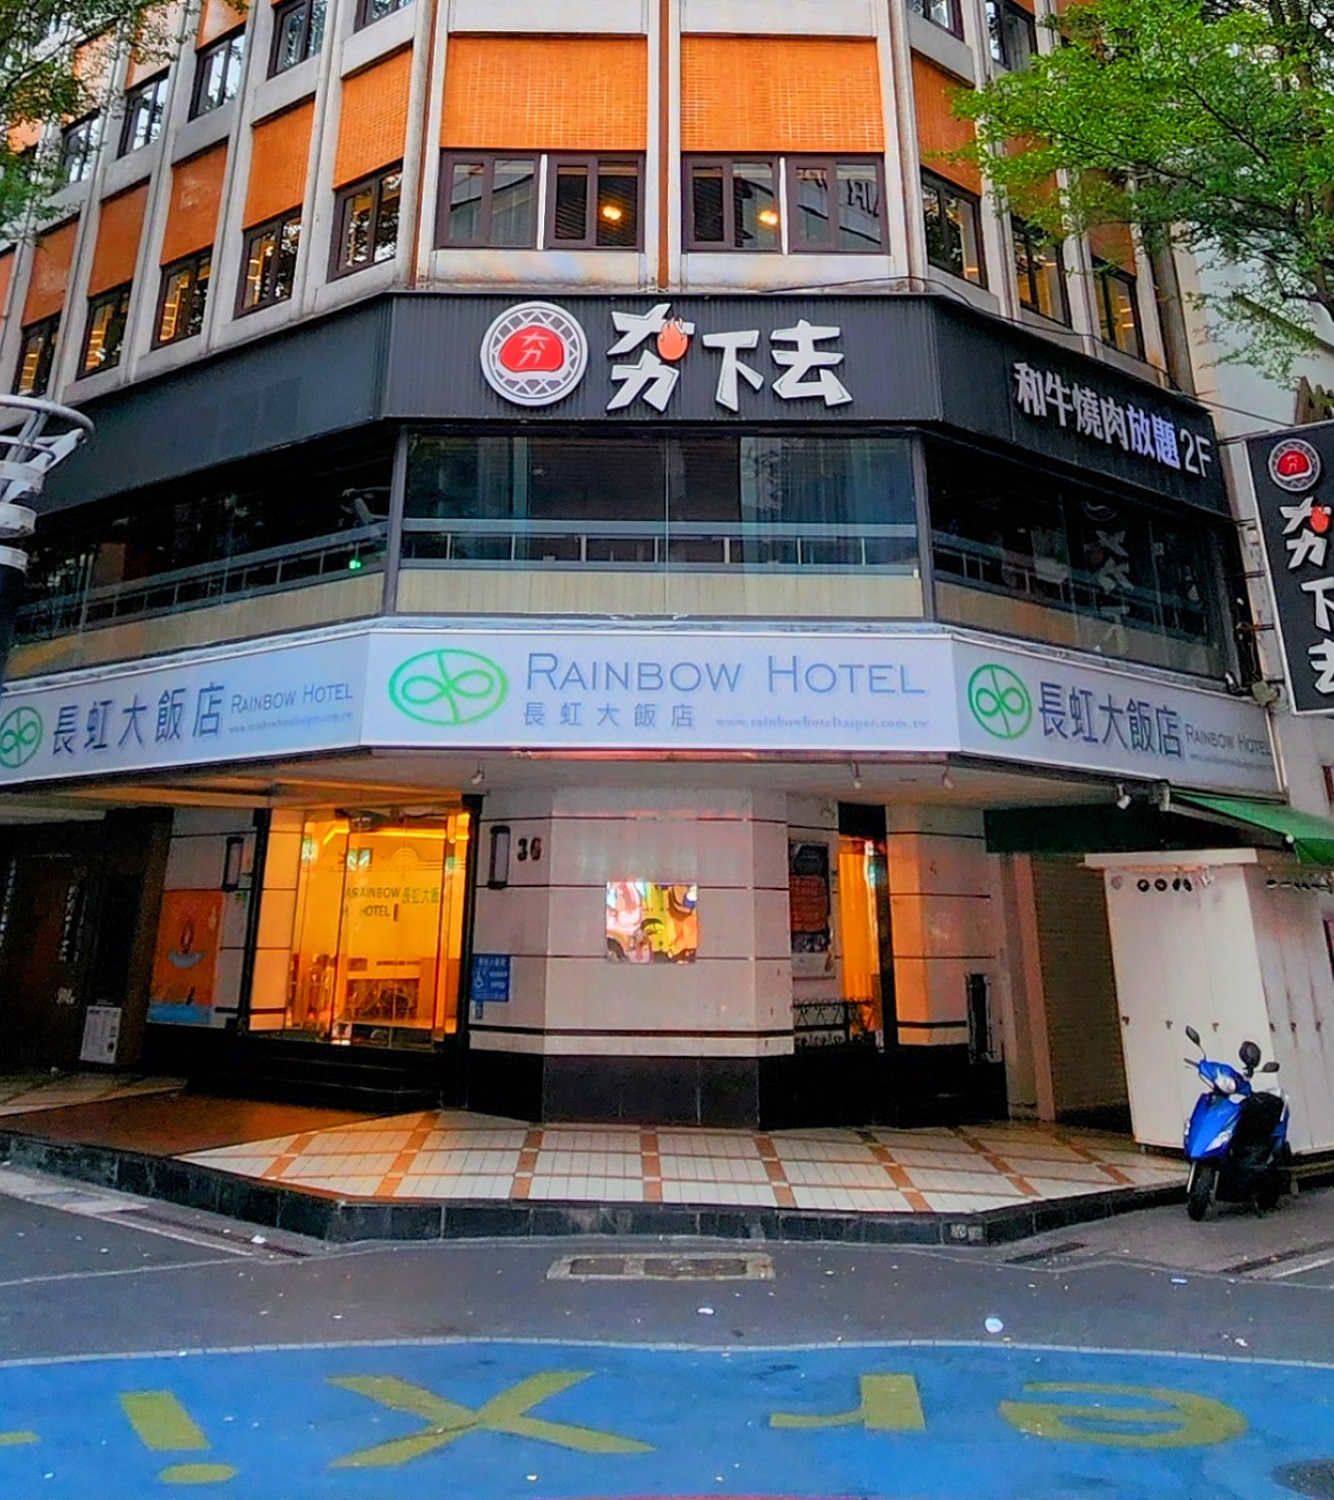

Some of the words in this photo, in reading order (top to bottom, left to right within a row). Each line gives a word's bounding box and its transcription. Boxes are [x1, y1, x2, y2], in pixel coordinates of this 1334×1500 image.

[606, 303, 853, 412] 夯下去
[526, 652, 744, 693] RAINBOW
[768, 655, 927, 695] HOTEL
[52, 681, 225, 755] 長虹大飯店
[230, 690, 297, 714] RAINBOW
[303, 681, 354, 705] HOTEL
[523, 702, 696, 729] 長虹大飯店
[1038, 681, 1182, 759] 長虹大飯店
